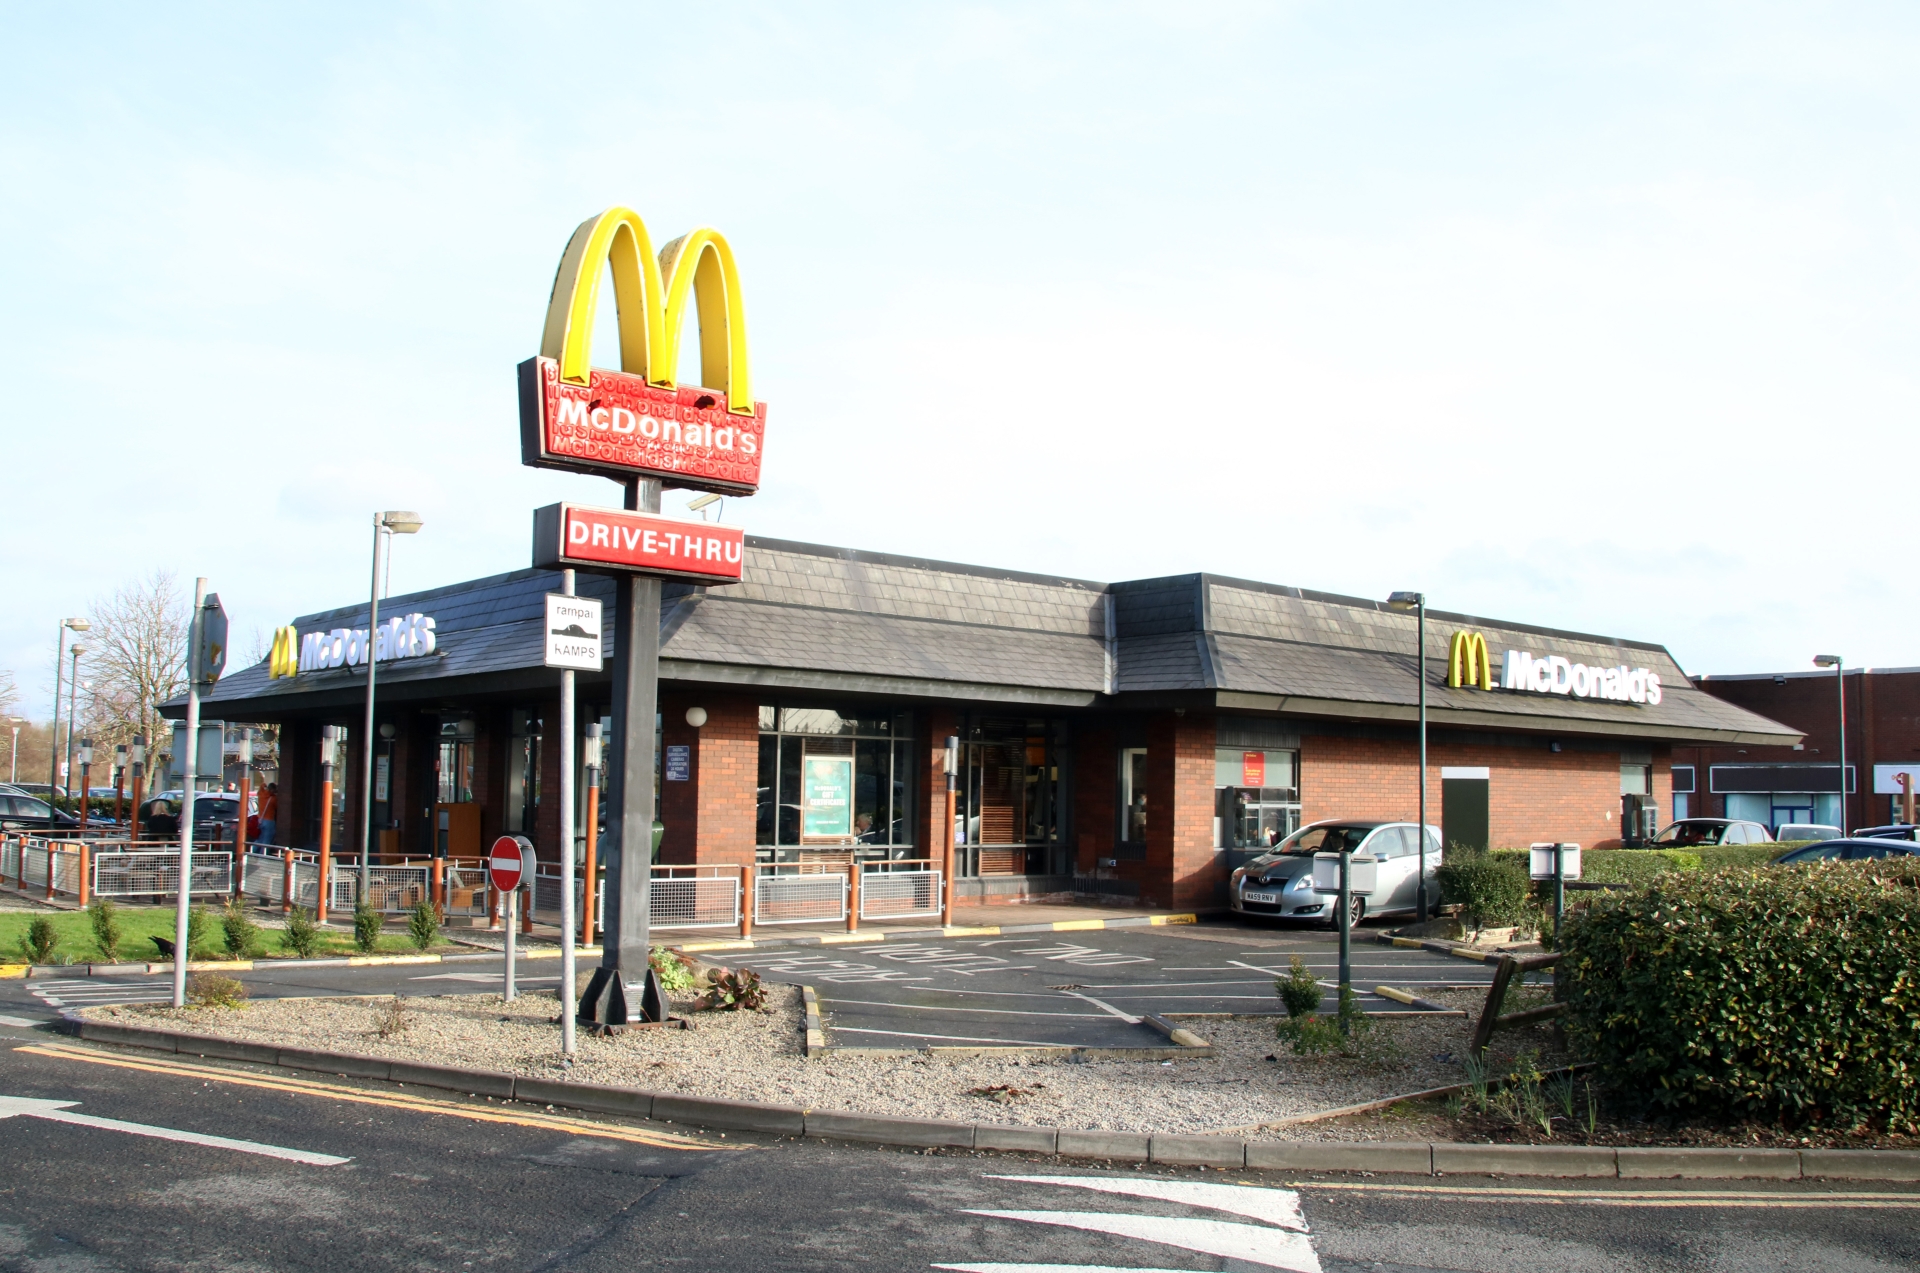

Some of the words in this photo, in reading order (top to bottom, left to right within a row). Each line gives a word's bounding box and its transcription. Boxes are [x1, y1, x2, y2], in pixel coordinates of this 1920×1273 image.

[557, 397, 757, 455] McDonald's
[569, 520, 741, 563] DRIVE-THRU
[300, 612, 437, 672] McDonald's
[1501, 649, 1662, 705] McDonald's
